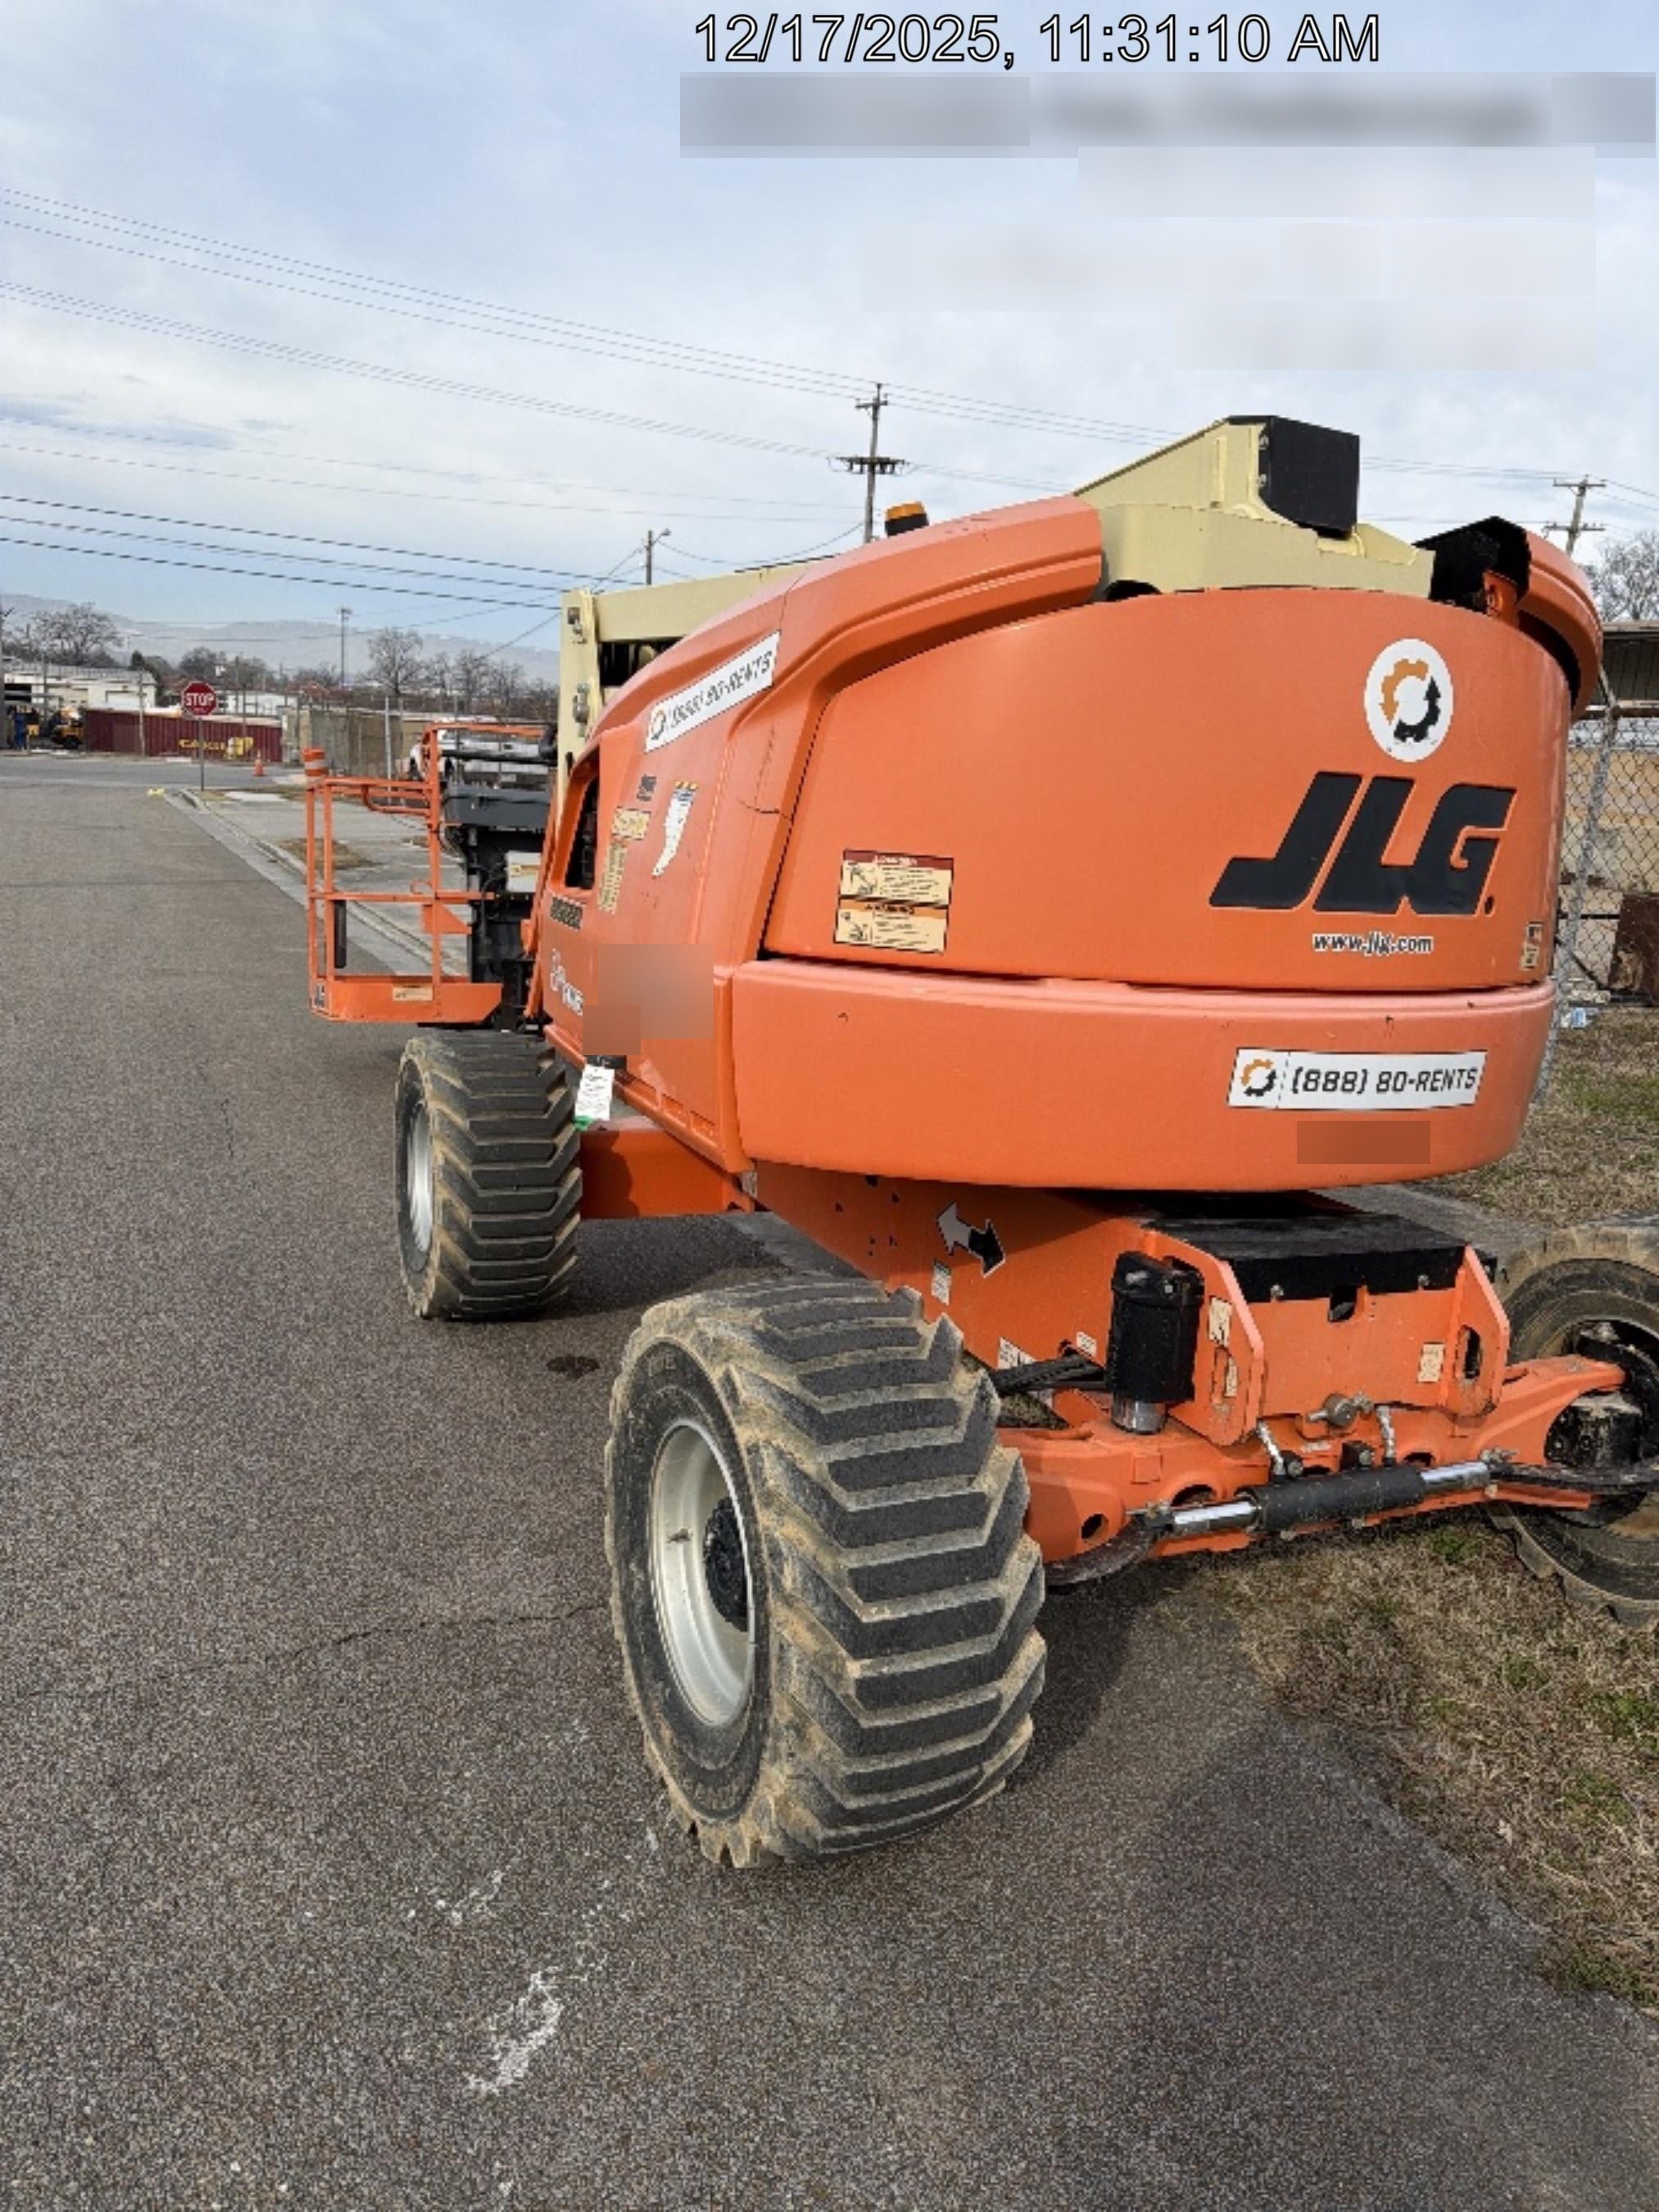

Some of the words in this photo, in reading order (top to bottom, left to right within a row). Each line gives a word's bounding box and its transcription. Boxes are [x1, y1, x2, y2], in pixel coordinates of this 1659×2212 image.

[185, 693, 215, 706] STOP
[1209, 771, 1517, 916] JLG
[1313, 931, 1432, 956] www.jlg.com
[1292, 1067, 1368, 1095] (888)
[1376, 1067, 1478, 1094] 80-RENTS
